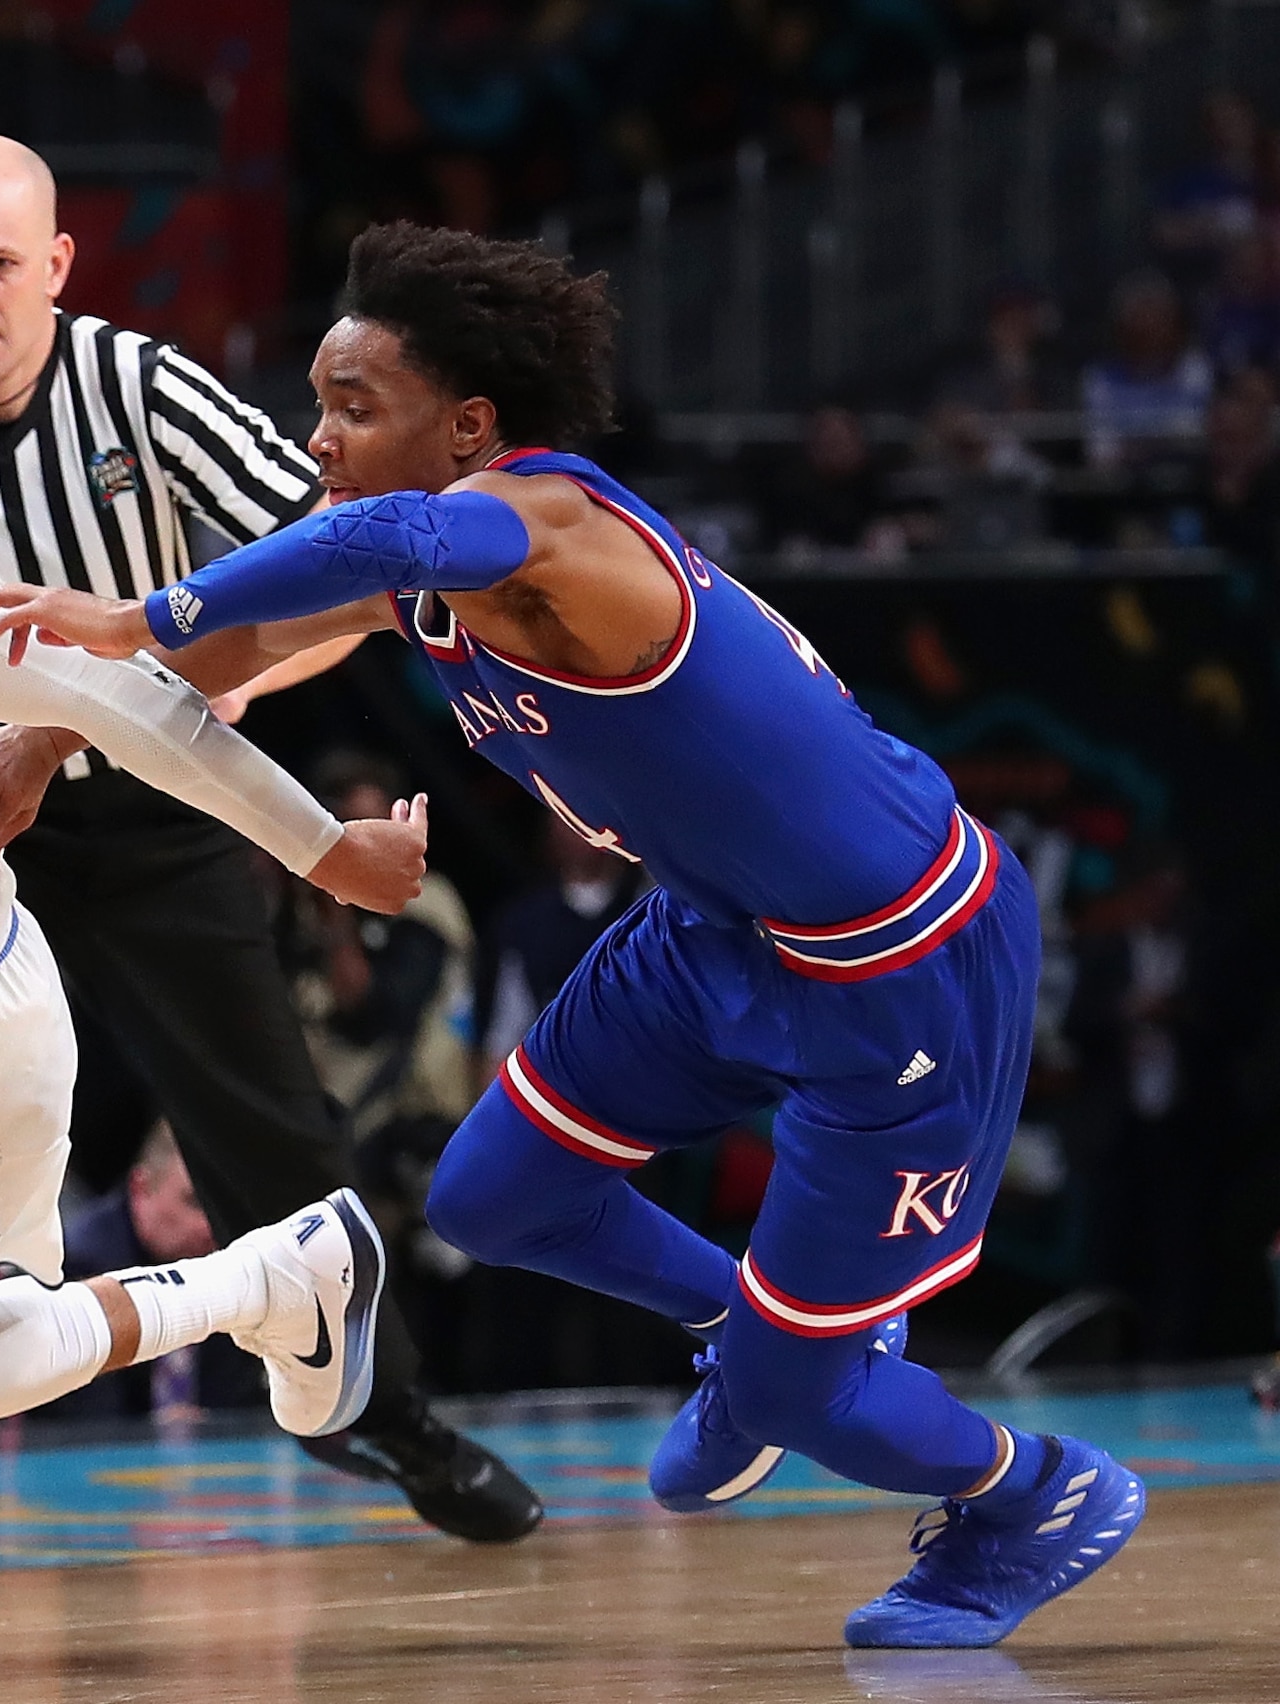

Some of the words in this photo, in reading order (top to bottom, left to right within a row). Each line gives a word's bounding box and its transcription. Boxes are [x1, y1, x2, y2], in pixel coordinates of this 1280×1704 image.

[168, 586, 193, 634] adidas
[529, 769, 642, 863] 4
[897, 1060, 937, 1086] adidas
